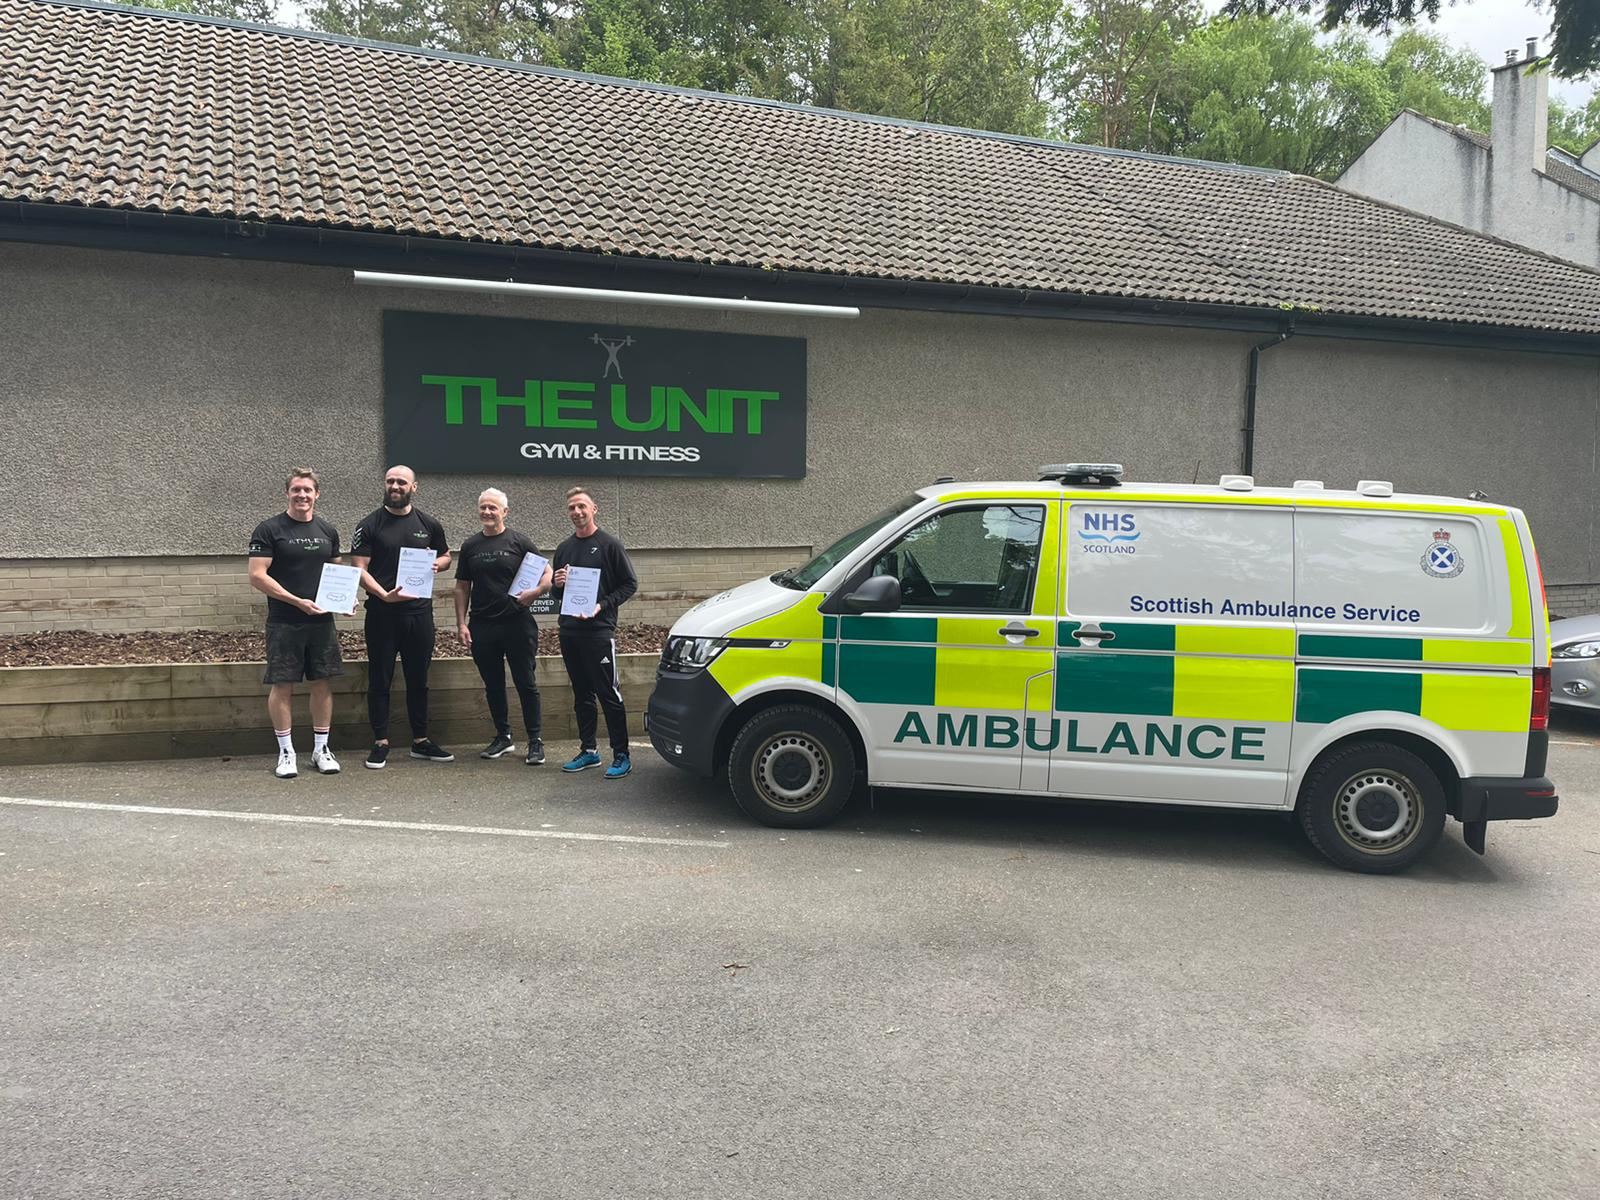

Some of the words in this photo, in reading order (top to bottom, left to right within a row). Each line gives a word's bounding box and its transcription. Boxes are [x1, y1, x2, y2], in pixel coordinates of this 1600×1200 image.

[421, 374, 598, 430] THE
[611, 383, 780, 435] UNIT
[519, 442, 580, 459] GYM
[582, 444, 602, 460] &
[605, 445, 701, 462] FITNESS
[1084, 512, 1136, 532] NHS
[1083, 544, 1136, 554] SCOTLAND
[1130, 595, 1213, 614] Scottish
[1220, 599, 1336, 619] Ambulance
[1342, 603, 1421, 622] Service
[893, 711, 1267, 762] AMBULANCE
